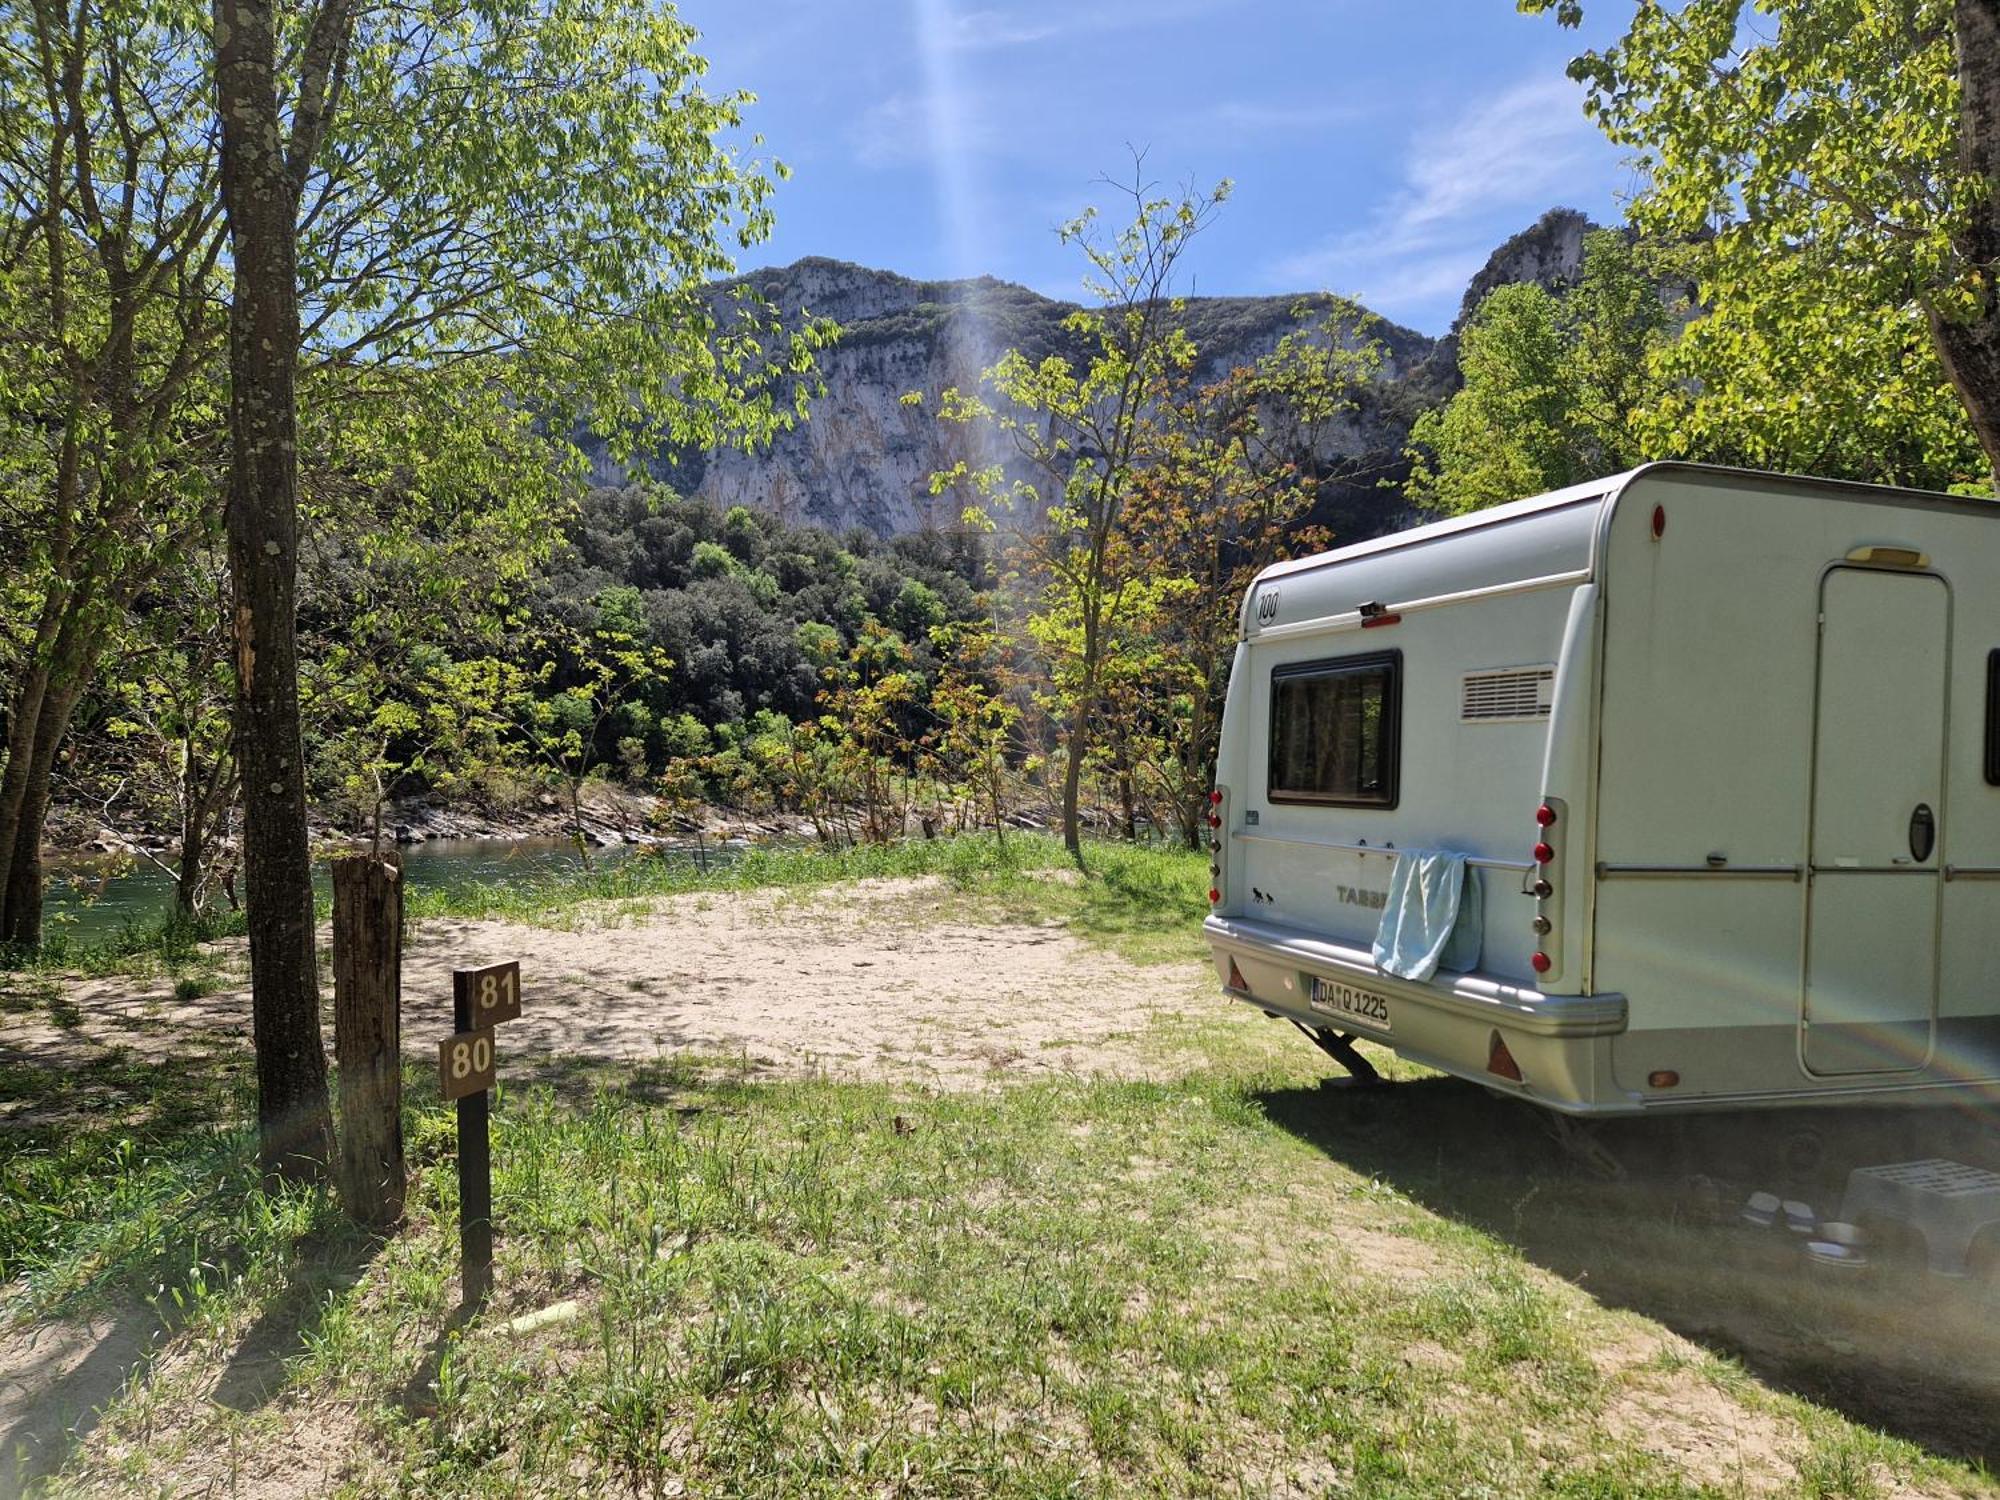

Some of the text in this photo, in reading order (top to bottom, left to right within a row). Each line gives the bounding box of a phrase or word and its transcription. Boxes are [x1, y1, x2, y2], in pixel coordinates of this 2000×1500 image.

[1258, 592, 1280, 619] 100
[480, 970, 514, 1009] 81
[1319, 982, 1388, 1020] DA Q 1225
[452, 1037, 490, 1079] 80
